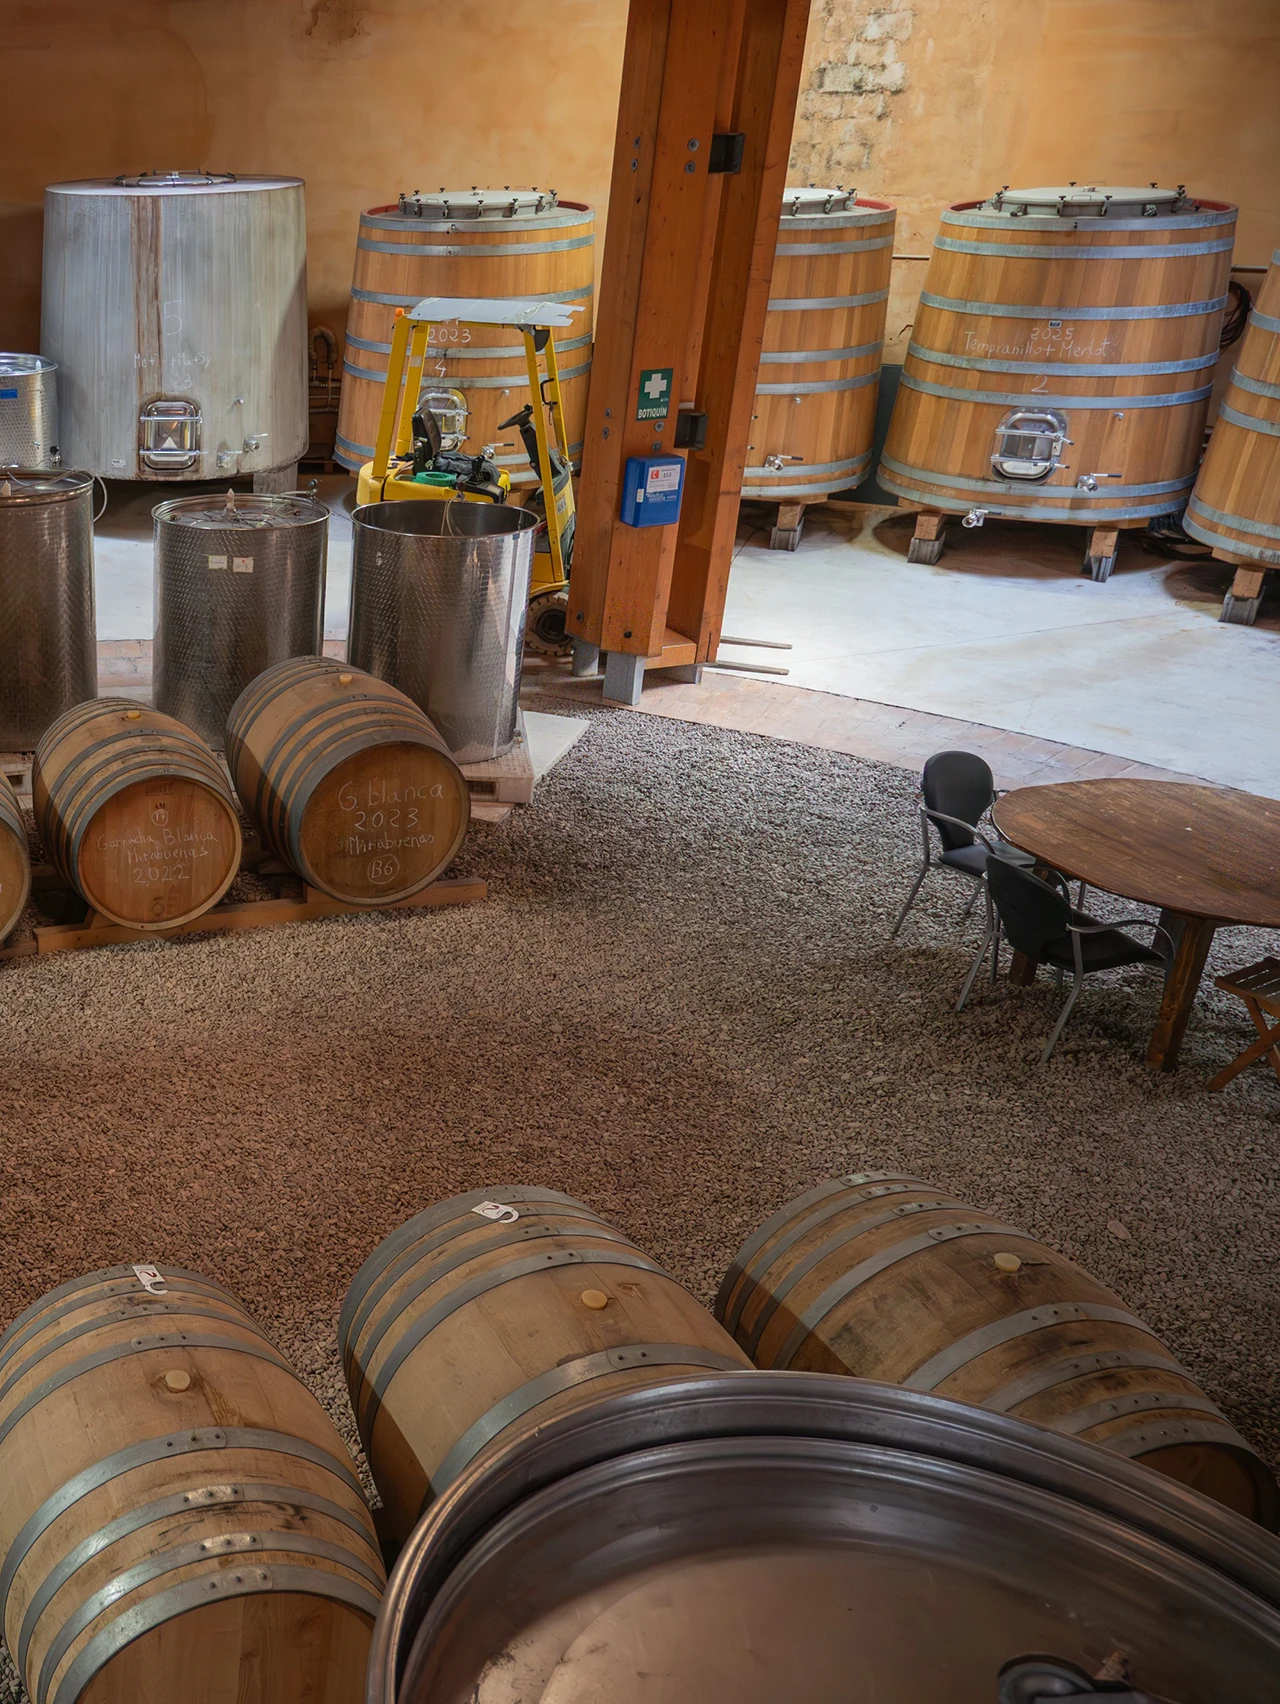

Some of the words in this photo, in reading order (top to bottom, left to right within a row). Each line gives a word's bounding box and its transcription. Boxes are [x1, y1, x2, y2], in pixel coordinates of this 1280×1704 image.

[163, 300, 183, 336] 5
[427, 328, 471, 343] 2023
[1031, 327, 1075, 341] 2025
[1059, 336, 1111, 357] Merlot
[435, 359, 447, 377] 4
[1031, 374, 1048, 393] 2
[637, 405, 668, 419] BOTIQUÍN
[368, 779, 444, 807] blanca
[355, 807, 418, 830] 2023
[162, 828, 218, 845] Blanca
[349, 832, 435, 855] Mirabuenas
[133, 865, 189, 884] 2022
[372, 860, 393, 879] B6
